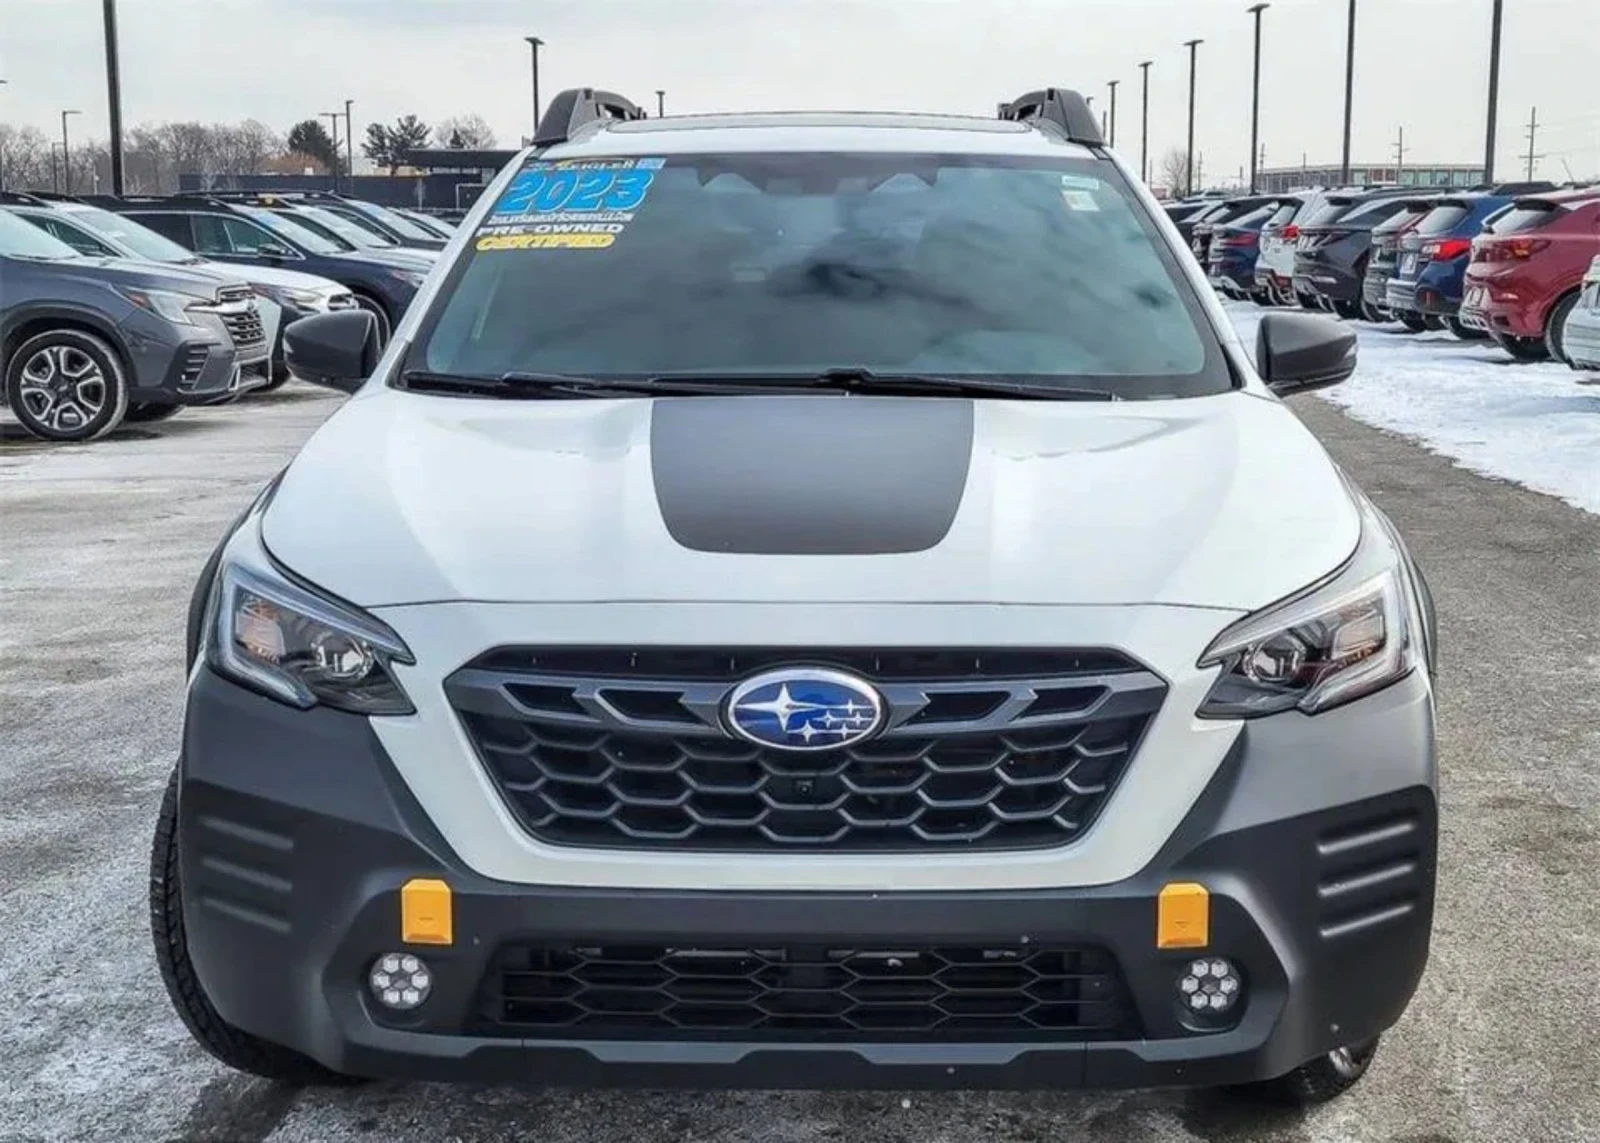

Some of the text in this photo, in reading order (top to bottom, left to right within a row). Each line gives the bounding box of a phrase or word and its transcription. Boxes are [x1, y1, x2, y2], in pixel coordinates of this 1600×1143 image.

[494, 168, 655, 214] 2023
[475, 223, 625, 237] PRE-OWNED
[476, 233, 616, 251] CERTIFIED
